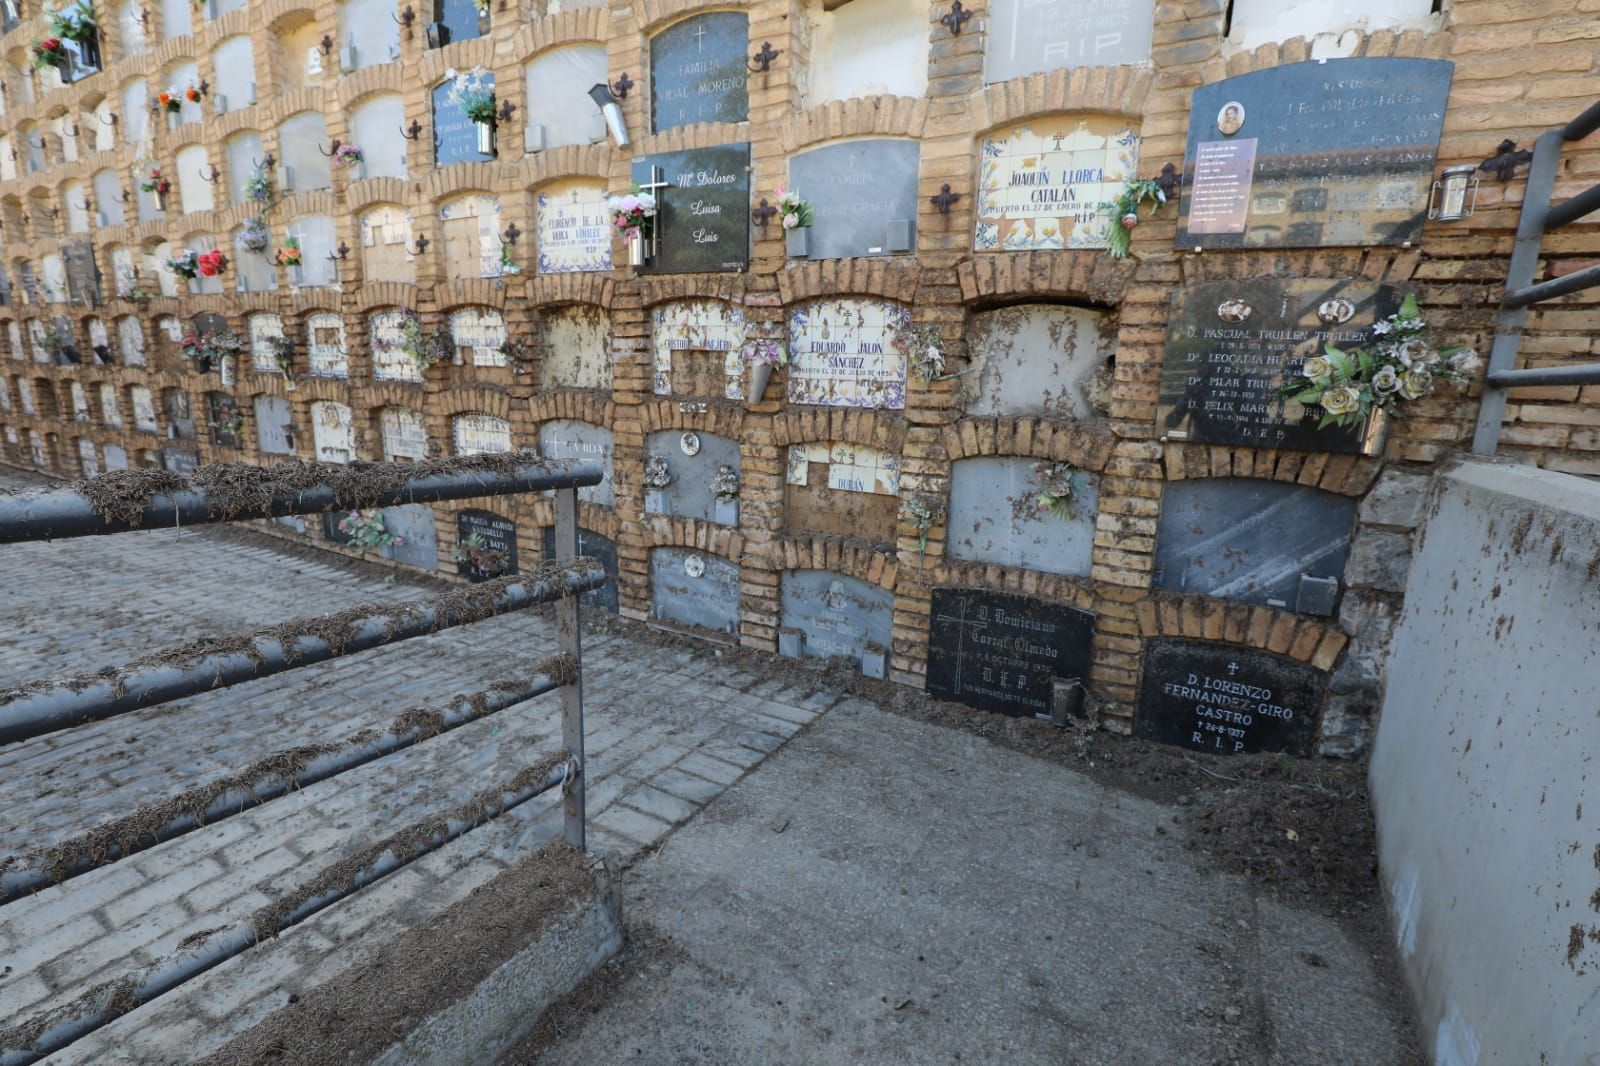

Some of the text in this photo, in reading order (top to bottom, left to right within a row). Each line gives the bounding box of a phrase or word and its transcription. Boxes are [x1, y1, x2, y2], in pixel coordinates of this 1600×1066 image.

[698, 75, 744, 95] MORENO
[697, 169, 737, 186] Dolores
[1009, 166, 1105, 186] JOAQUÍN LLORCA
[690, 200, 721, 215] Luisa
[692, 228, 719, 243] Luis
[1203, 328, 1251, 340] PASCUAL
[811, 339, 883, 354] EDUARDO JALÓN
[1208, 353, 1264, 364] LEOCADIA
[1209, 378, 1240, 388] PILAR
[1204, 401, 1234, 412] FELIX
[838, 478, 865, 492] DURÁN
[995, 608, 1056, 633] Domiciano
[1015, 637, 1059, 658] Olmedo
[1188, 674, 1272, 701] D. LORENZO
[1164, 682, 1294, 720] FERNANDEZ-GIRO
[1196, 704, 1253, 726] CASTRO
[1192, 732, 1205, 744] R.
